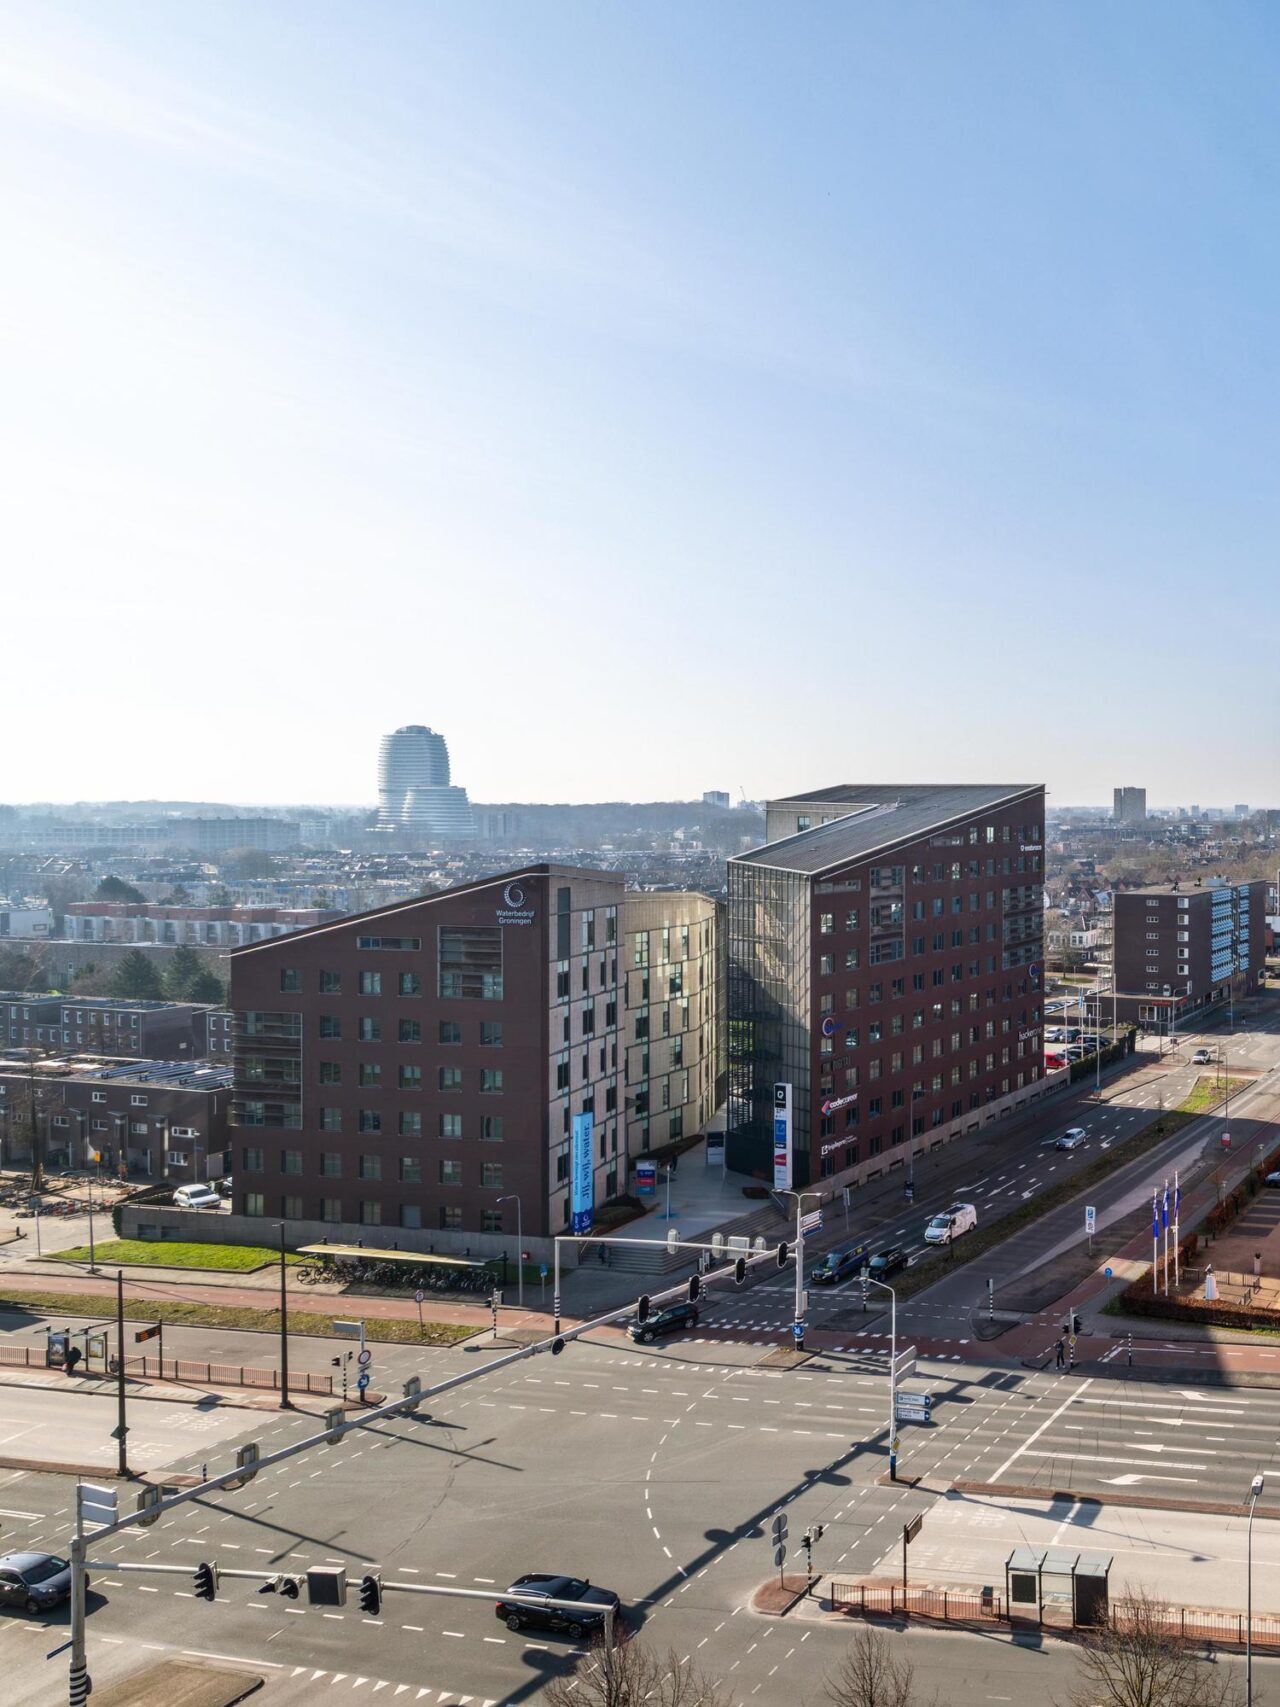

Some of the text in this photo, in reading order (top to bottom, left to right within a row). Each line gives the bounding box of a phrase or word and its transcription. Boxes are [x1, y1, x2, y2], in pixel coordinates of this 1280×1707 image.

[496, 910, 534, 918] Waterbedrijf
[499, 917, 531, 925] Groningen
[582, 1159, 590, 1180] wij,
[582, 1181, 590, 1199] Jij,
